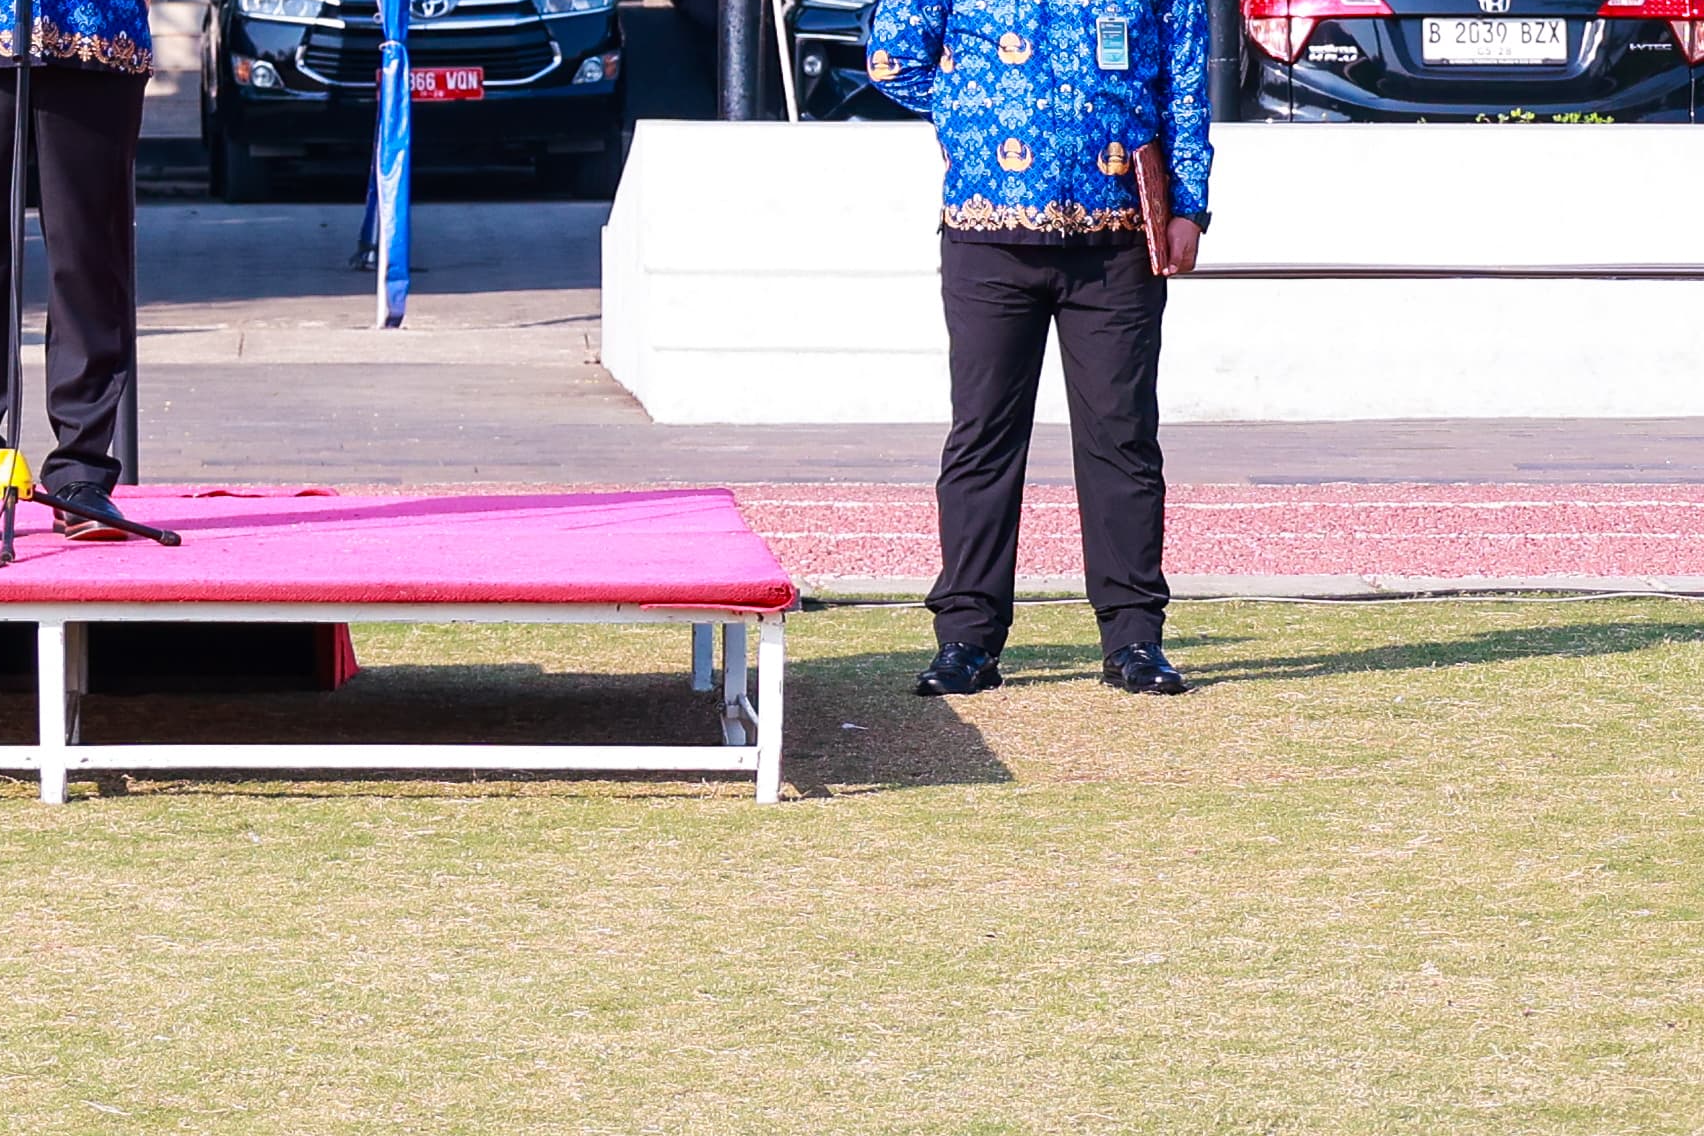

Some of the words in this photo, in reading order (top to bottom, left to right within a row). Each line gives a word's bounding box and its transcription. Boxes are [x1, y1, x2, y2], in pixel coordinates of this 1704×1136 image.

[1429, 22, 1441, 44] B
[1455, 21, 1508, 44] 2039
[1521, 21, 1560, 44] BZX
